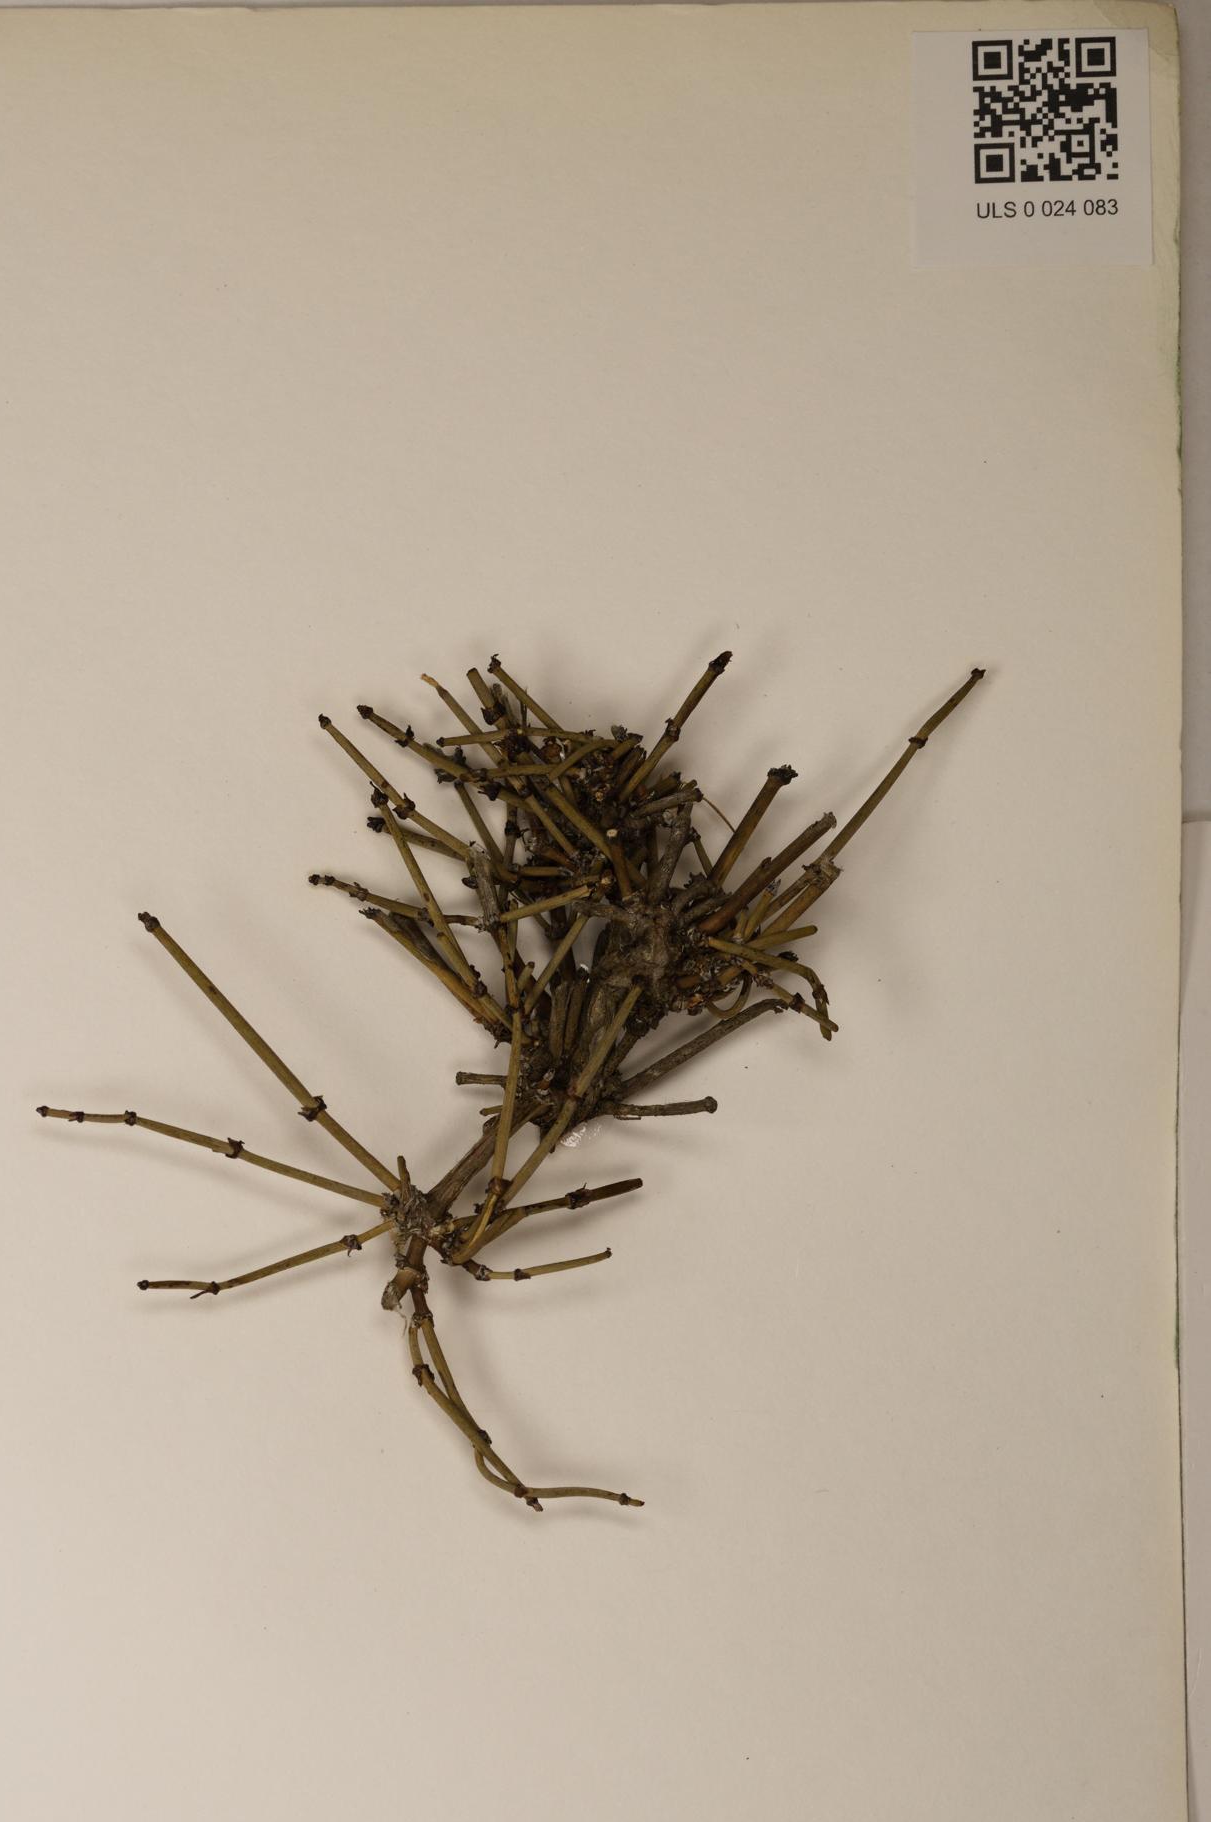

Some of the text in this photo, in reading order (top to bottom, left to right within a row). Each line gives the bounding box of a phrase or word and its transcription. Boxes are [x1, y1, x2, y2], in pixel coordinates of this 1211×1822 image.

[976, 198, 1119, 219] ULS 0 024 083
